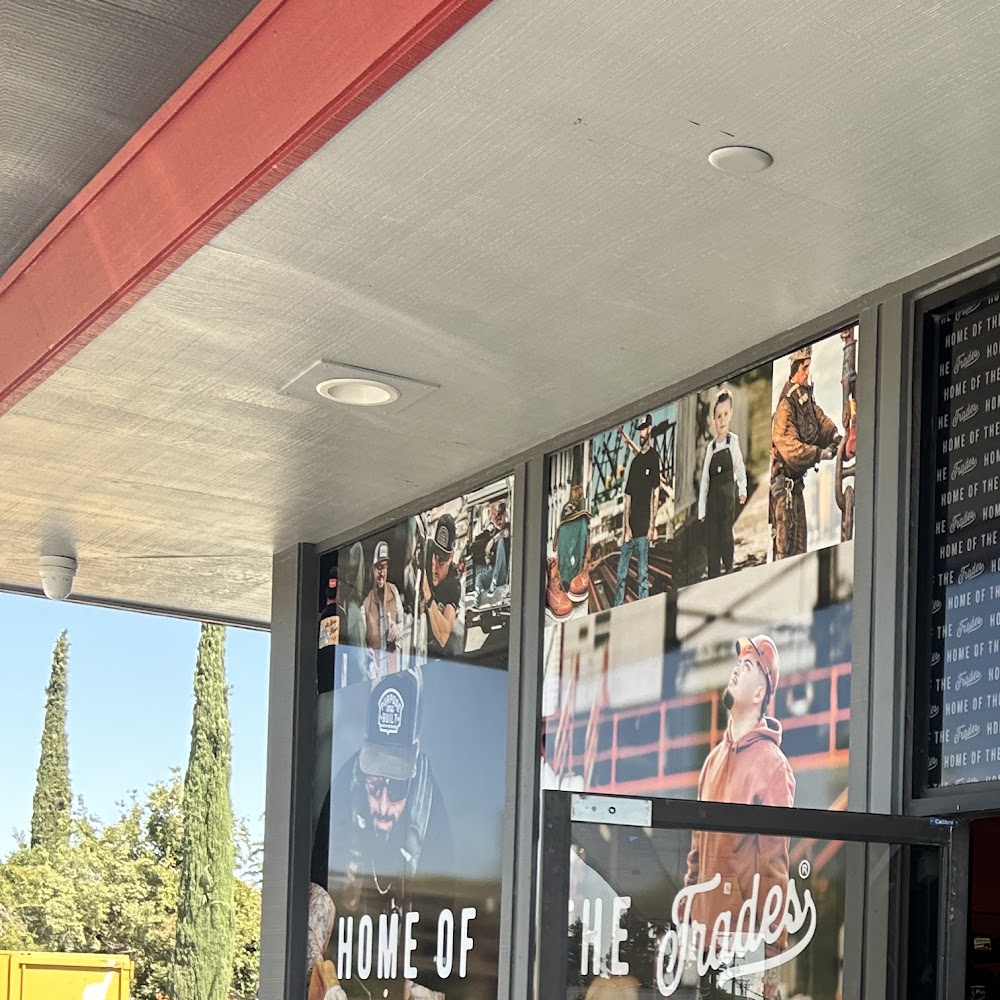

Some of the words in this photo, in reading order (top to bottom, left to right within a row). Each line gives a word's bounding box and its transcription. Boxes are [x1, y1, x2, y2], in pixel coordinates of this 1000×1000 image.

[945, 326, 968, 348] HOME
[972, 320, 982, 337] OF
[942, 433, 965, 453] HOME
[969, 428, 980, 444] OF
[983, 421, 1000, 439] THE
[947, 591, 971, 610] HOME
[975, 588, 985, 603] OF
[935, 676, 951, 692] THE
[955, 670, 981, 691] Trades
[944, 752, 967, 768] HOME
[971, 750, 981, 764] OF
[985, 746, 1000, 762] THE
[337, 912, 420, 980] HOME
[436, 907, 476, 979] OF
[569, 896, 632, 977] HE
